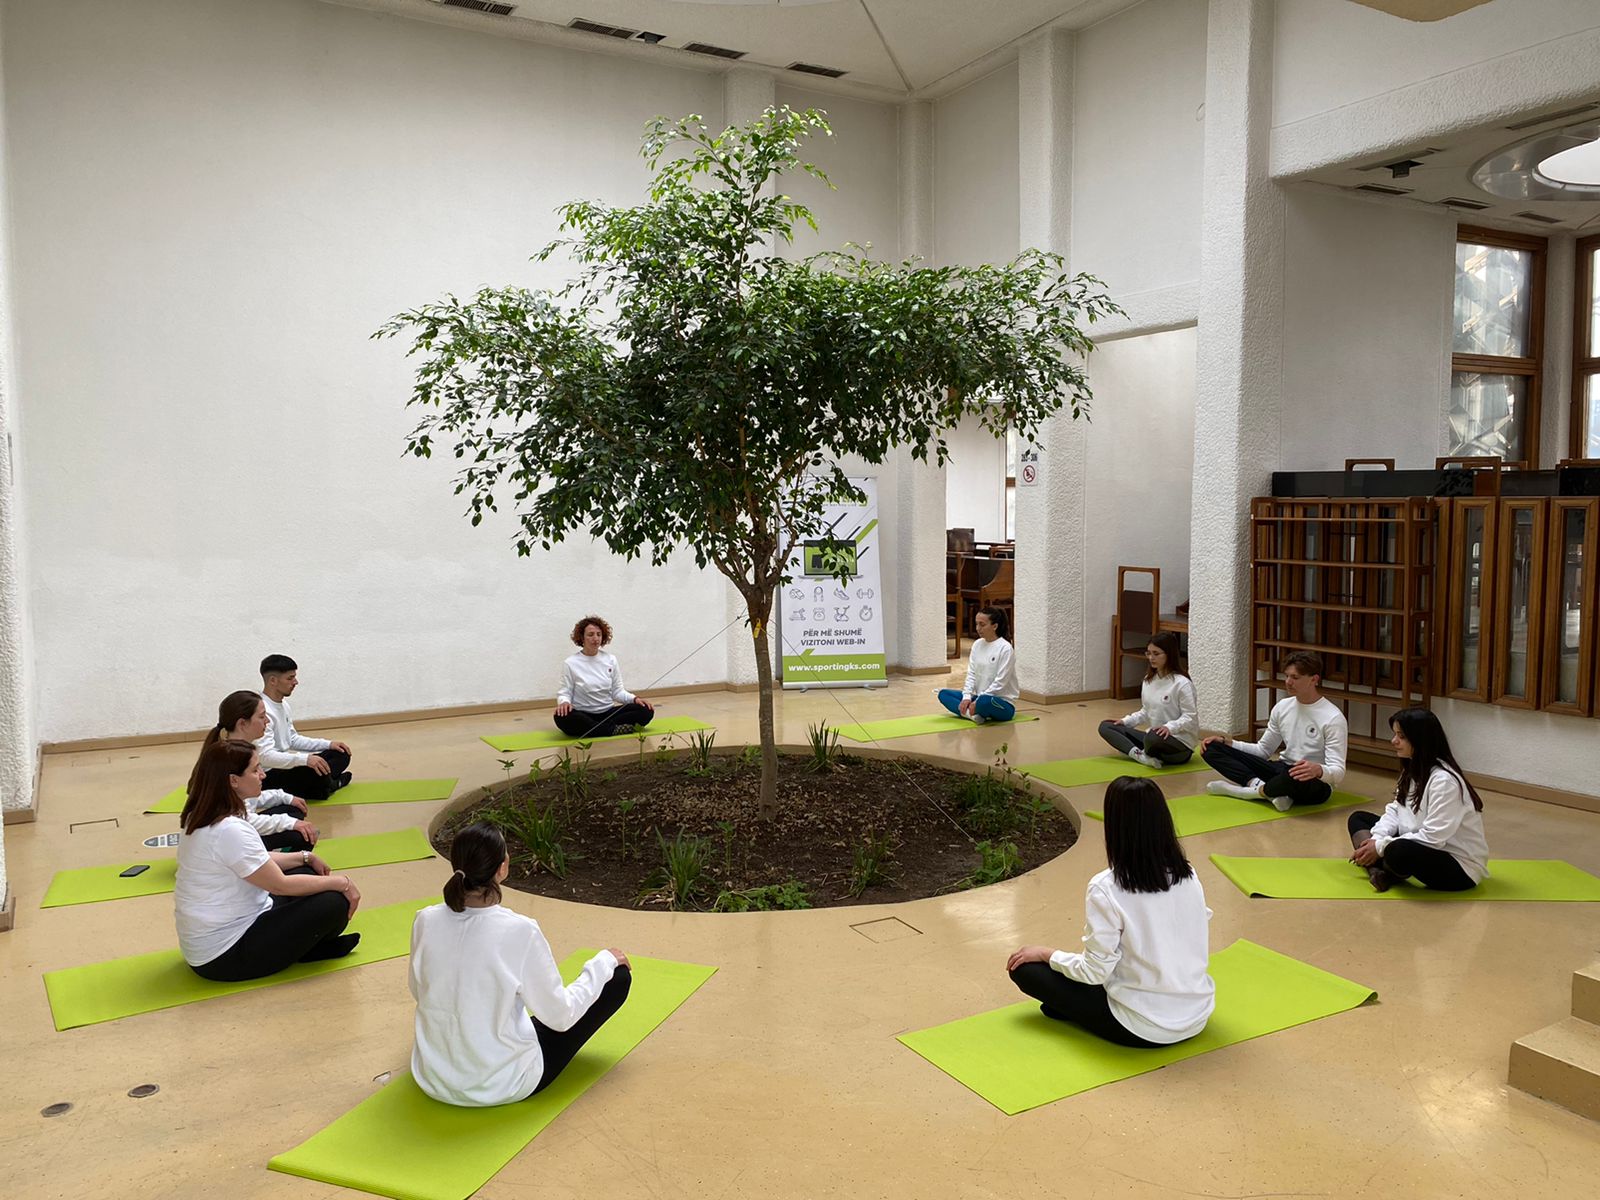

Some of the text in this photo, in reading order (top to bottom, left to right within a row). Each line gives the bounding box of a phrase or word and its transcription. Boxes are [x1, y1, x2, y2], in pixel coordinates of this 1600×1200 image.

[803, 628, 862, 637] PËR MË SHUMË
[788, 662, 880, 672] www.sportingks.com
